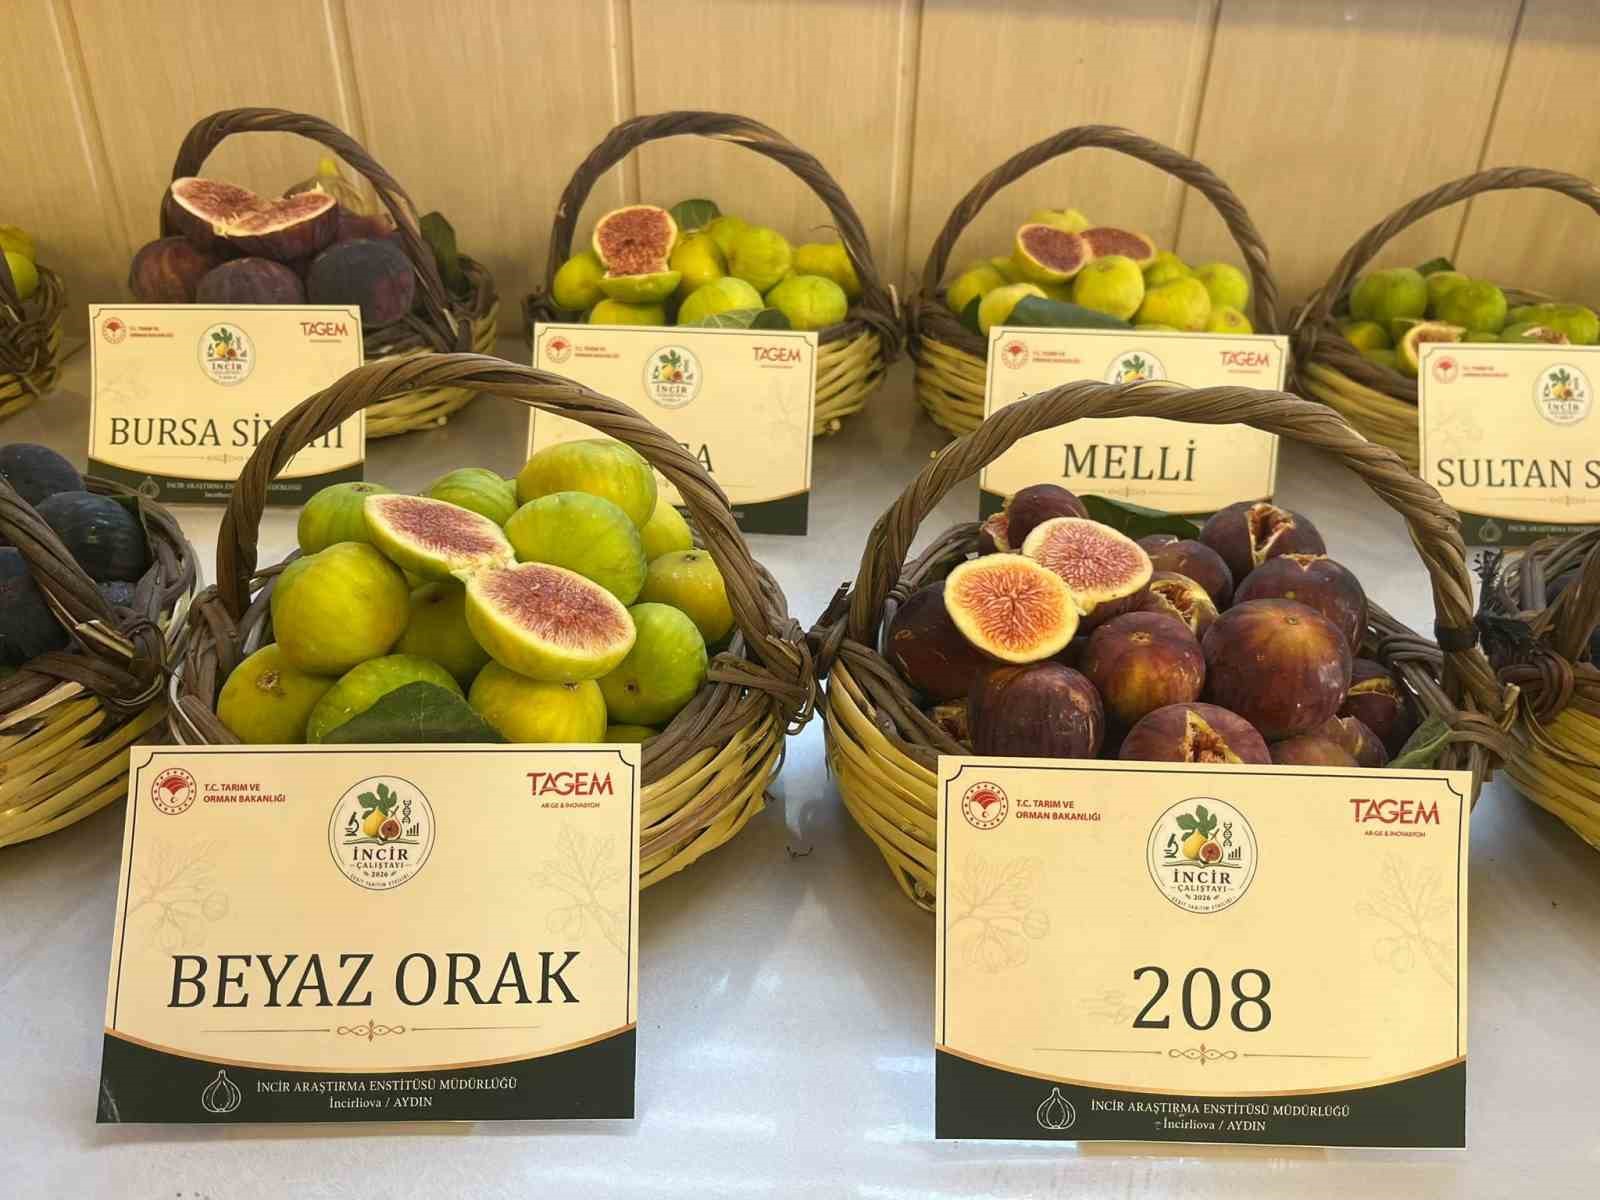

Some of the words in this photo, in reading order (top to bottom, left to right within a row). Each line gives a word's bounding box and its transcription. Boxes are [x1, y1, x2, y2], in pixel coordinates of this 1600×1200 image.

[299, 321, 349, 337] TAGEM
[751, 346, 801, 363] TAGEM
[1219, 351, 1270, 367] TAGEM
[109, 417, 222, 447] BURSA
[1062, 440, 1198, 482] MELLİ
[1437, 458, 1572, 489] SULTAN
[203, 783, 219, 792] T.C.
[220, 783, 248, 792] TARIM
[249, 783, 261, 792] VE
[526, 771, 614, 796] TAGEM
[203, 794, 238, 804] ORMAN
[238, 793, 286, 803] BAKANLIĞI
[1015, 799, 1032, 808] T.C.
[1033, 799, 1061, 809] TARIM
[1062, 800, 1075, 809] VE
[1015, 810, 1050, 820] ORMAN
[1051, 811, 1101, 822] BAKANLIĞI
[1349, 798, 1441, 825] TAGEM
[352, 845, 408, 861] İNCİR
[356, 861, 404, 870] ÇALIŞTAYI
[1173, 868, 1231, 885] İNCİR
[1177, 884, 1227, 893] ÇALIŞTAYI
[167, 952, 375, 1009] BEYAZ
[394, 951, 582, 1007] ORAK
[1132, 966, 1273, 1033] 208
[257, 1079, 290, 1093] İNCİR
[294, 1080, 366, 1094] ARAŞTIRMA
[369, 1077, 436, 1091] ENSTİTÜSÜ
[439, 1076, 518, 1090] MÜDÜRLÜĞÜ
[329, 1096, 382, 1109] İncirliova
[384, 1096, 391, 1108] /
[393, 1096, 433, 1108] AYDIN
[1091, 1099, 1124, 1112] İNCİR
[1128, 1101, 1200, 1117] ARAŞTIRMA
[1203, 1102, 1270, 1116] ENSTİTÜSÜ
[1272, 1104, 1350, 1118] MÜDÜRLÜĞÜ
[1163, 1115, 1215, 1131] İncirliova
[1217, 1119, 1225, 1131] /
[1226, 1119, 1266, 1132] AYDIN
